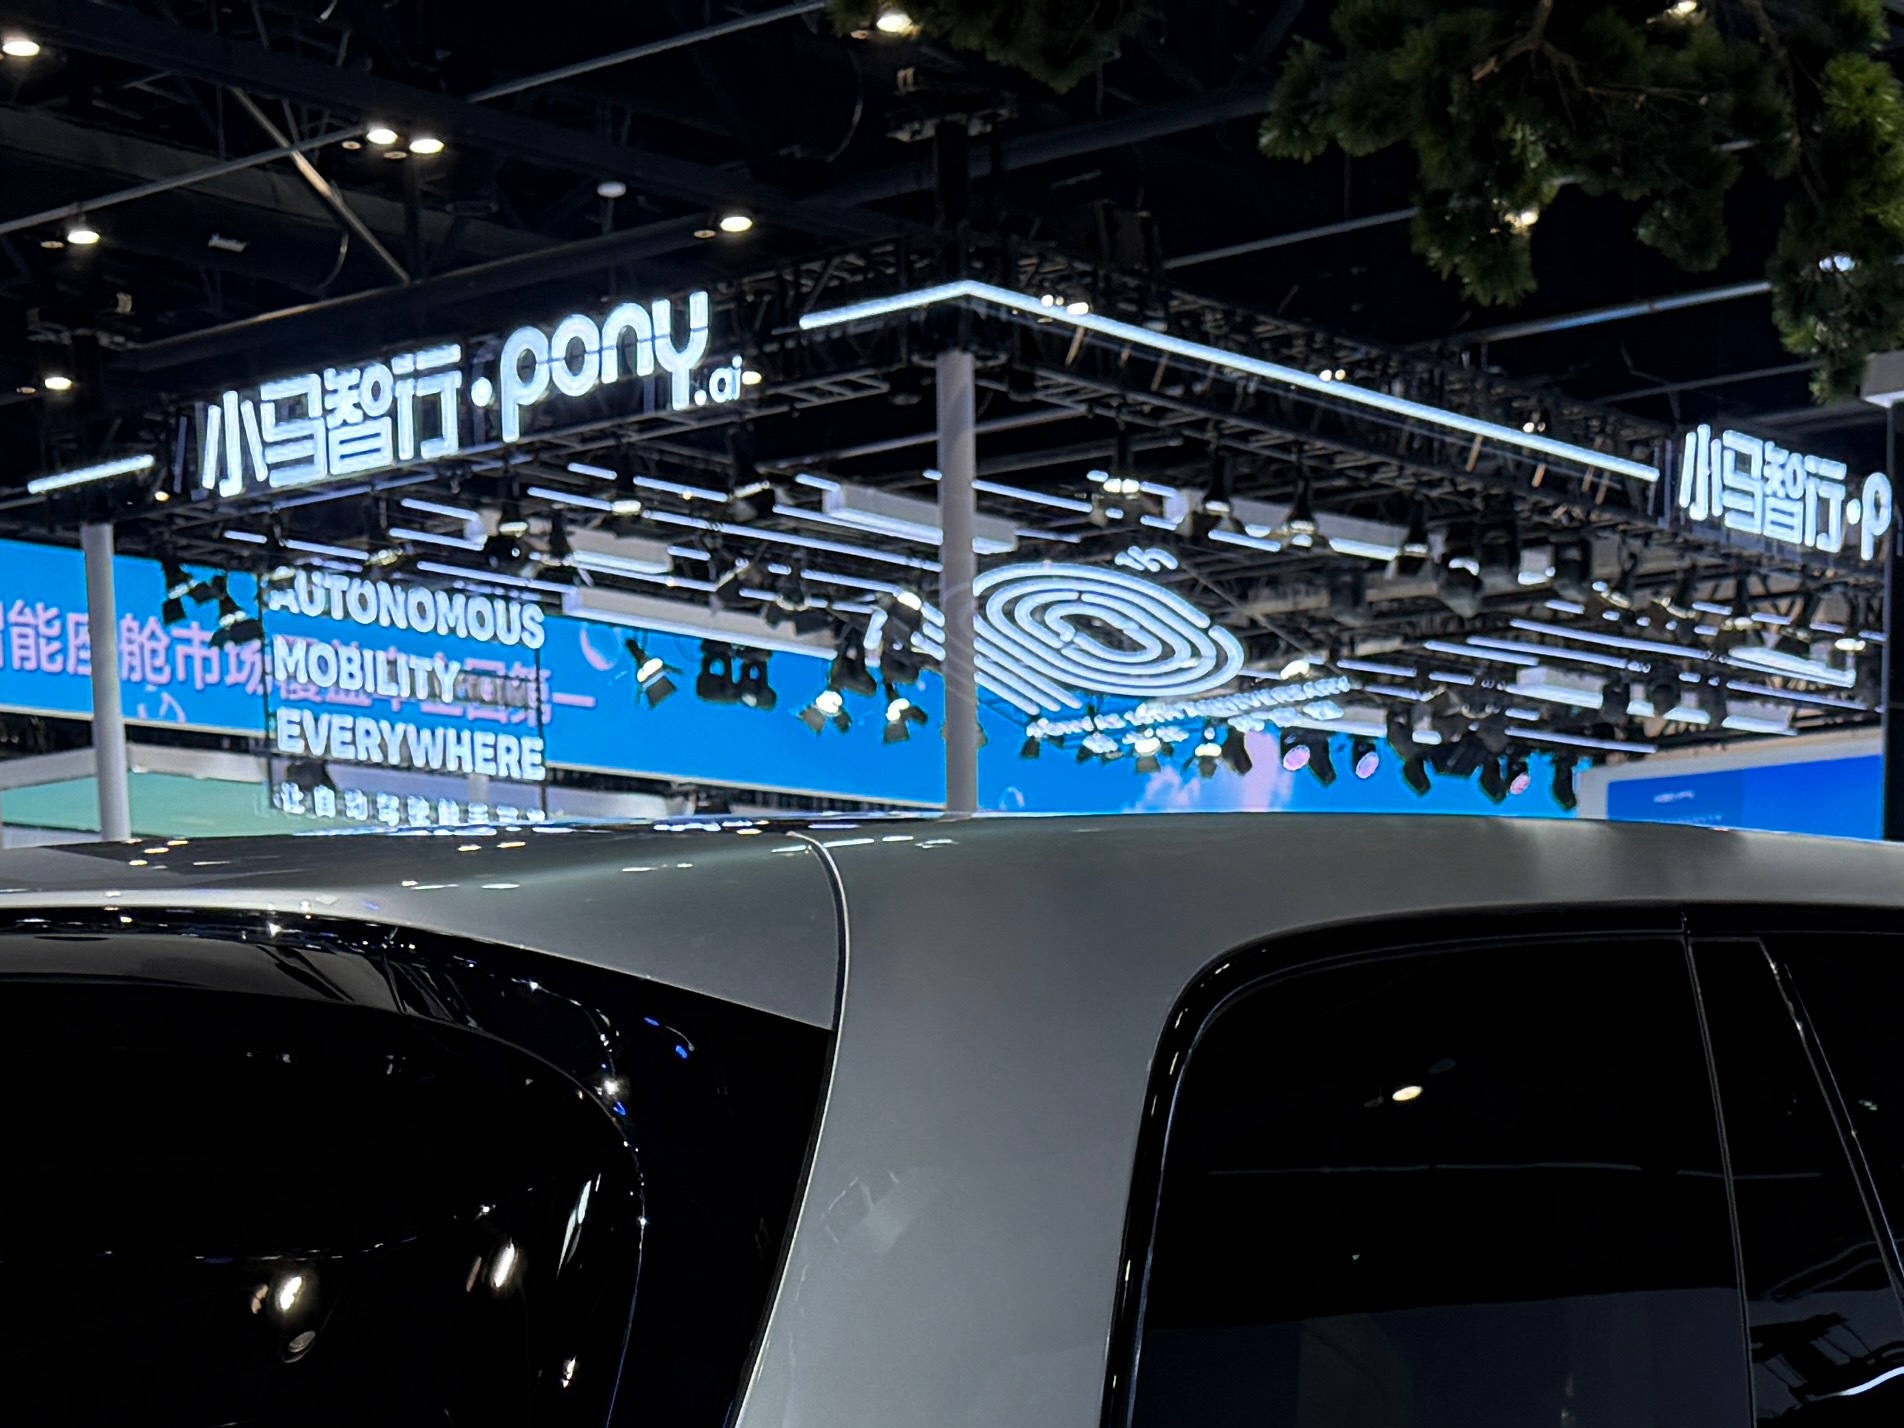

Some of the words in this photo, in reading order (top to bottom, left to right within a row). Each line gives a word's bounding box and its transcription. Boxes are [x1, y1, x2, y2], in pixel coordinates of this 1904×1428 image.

[269, 568, 546, 650] AUTONOMOUS
[272, 633, 462, 704] MOBILITY
[276, 707, 547, 783] EVERYWHERE
